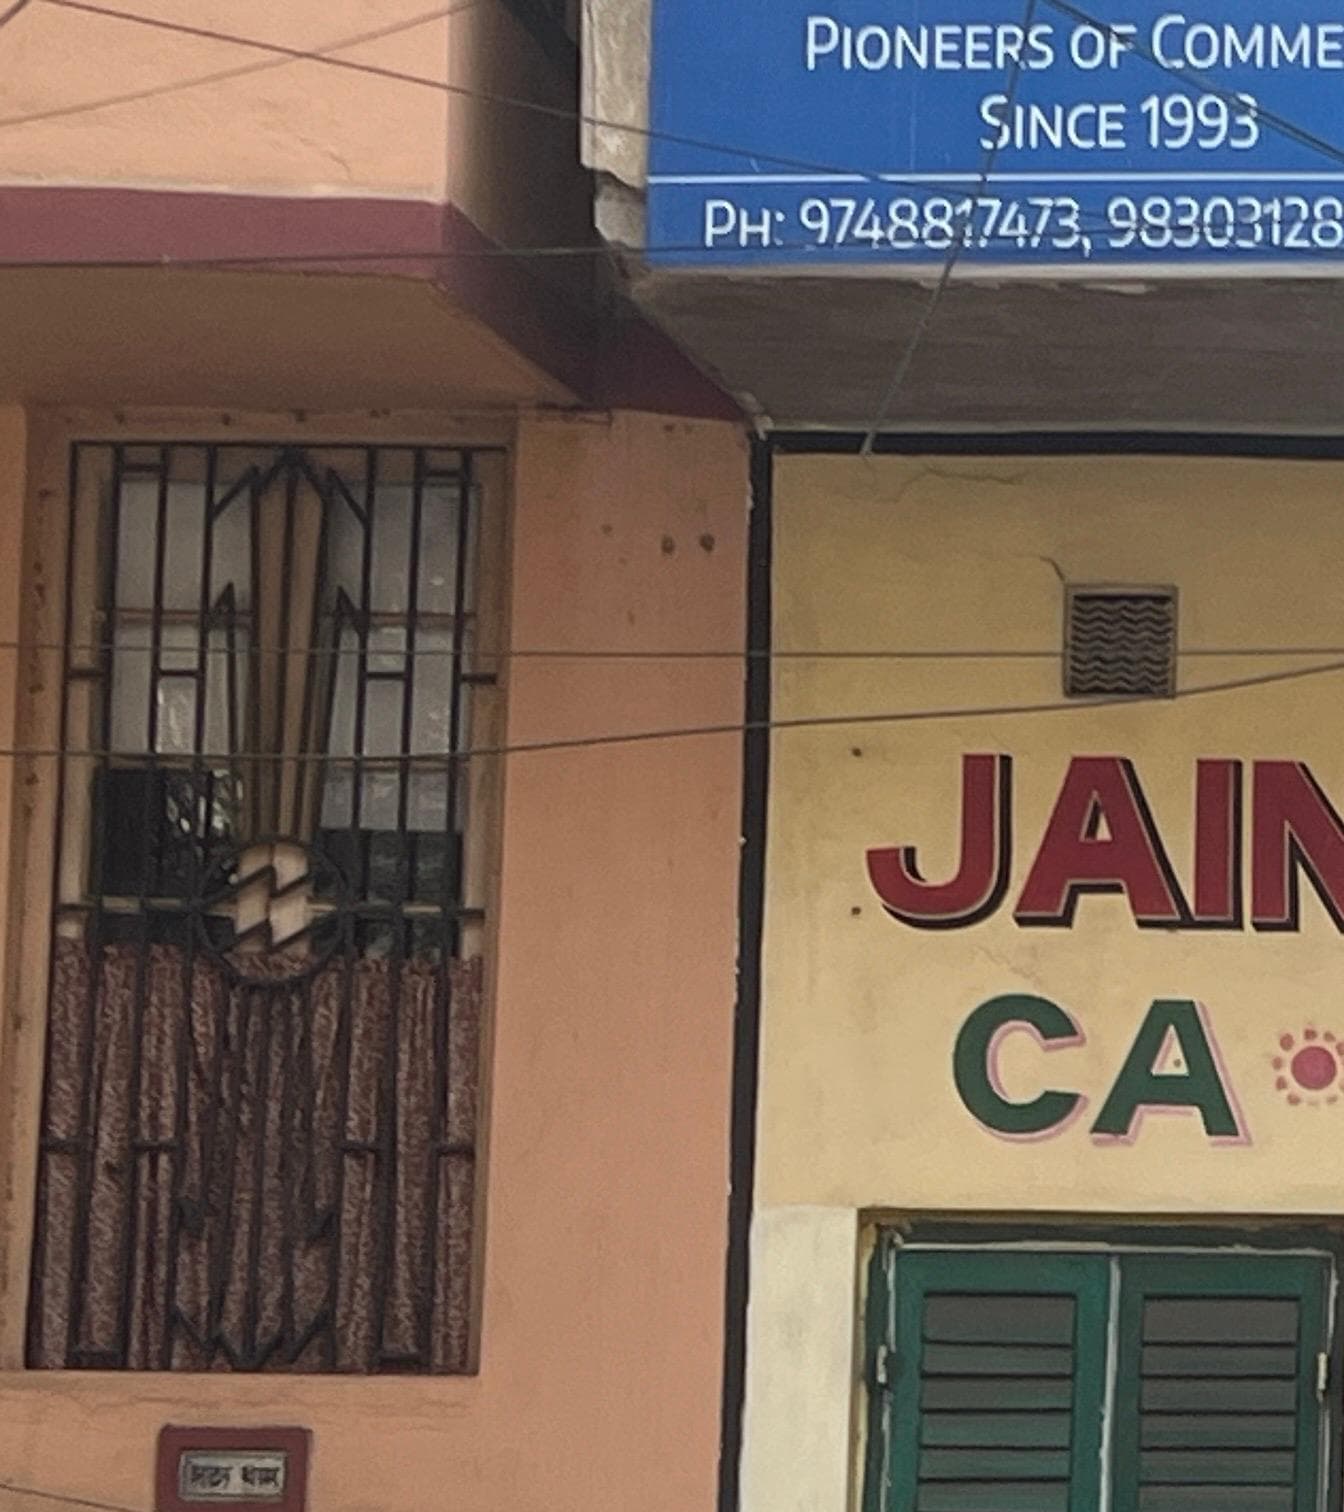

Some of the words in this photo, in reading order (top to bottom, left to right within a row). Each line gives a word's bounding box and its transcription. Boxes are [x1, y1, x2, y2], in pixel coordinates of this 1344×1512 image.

[805, 15, 1052, 71] PIONEERS
[1071, 24, 1137, 70] OF
[980, 94, 1126, 150] SINCE
[1142, 93, 1260, 150] 1993
[703, 200, 786, 248] PH:
[801, 200, 1091, 259] 9748817473,
[953, 993, 1252, 1147] CA
